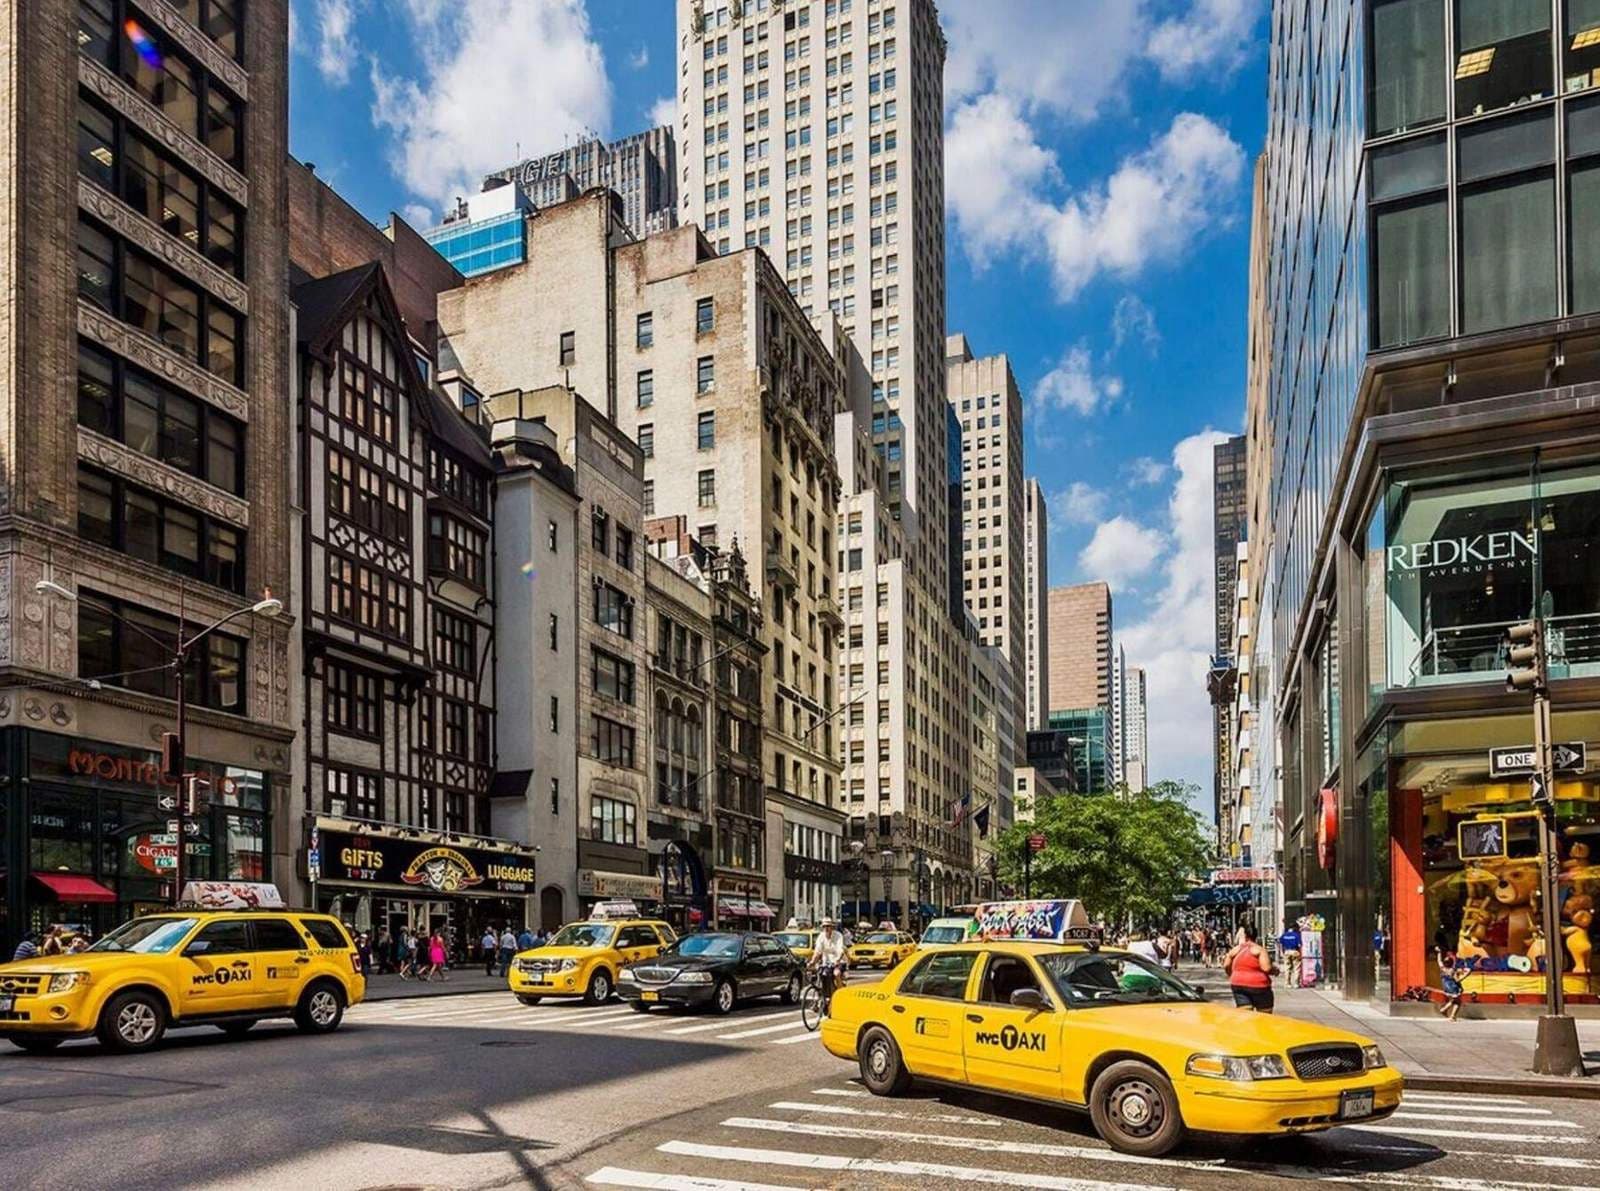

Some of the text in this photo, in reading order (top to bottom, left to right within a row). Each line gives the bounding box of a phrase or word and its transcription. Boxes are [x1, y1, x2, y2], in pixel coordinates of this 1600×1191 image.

[521, 152, 564, 187] GE
[1387, 528, 1538, 572] REDKEN
[1428, 565, 1494, 577] AVENUE
[1504, 754, 1533, 766] ONE
[341, 848, 383, 869] GIFTS
[487, 864, 534, 882] LUGGAGE
[192, 967, 251, 985] NYC TAXI
[976, 1024, 1046, 1052] NYC TAXI
